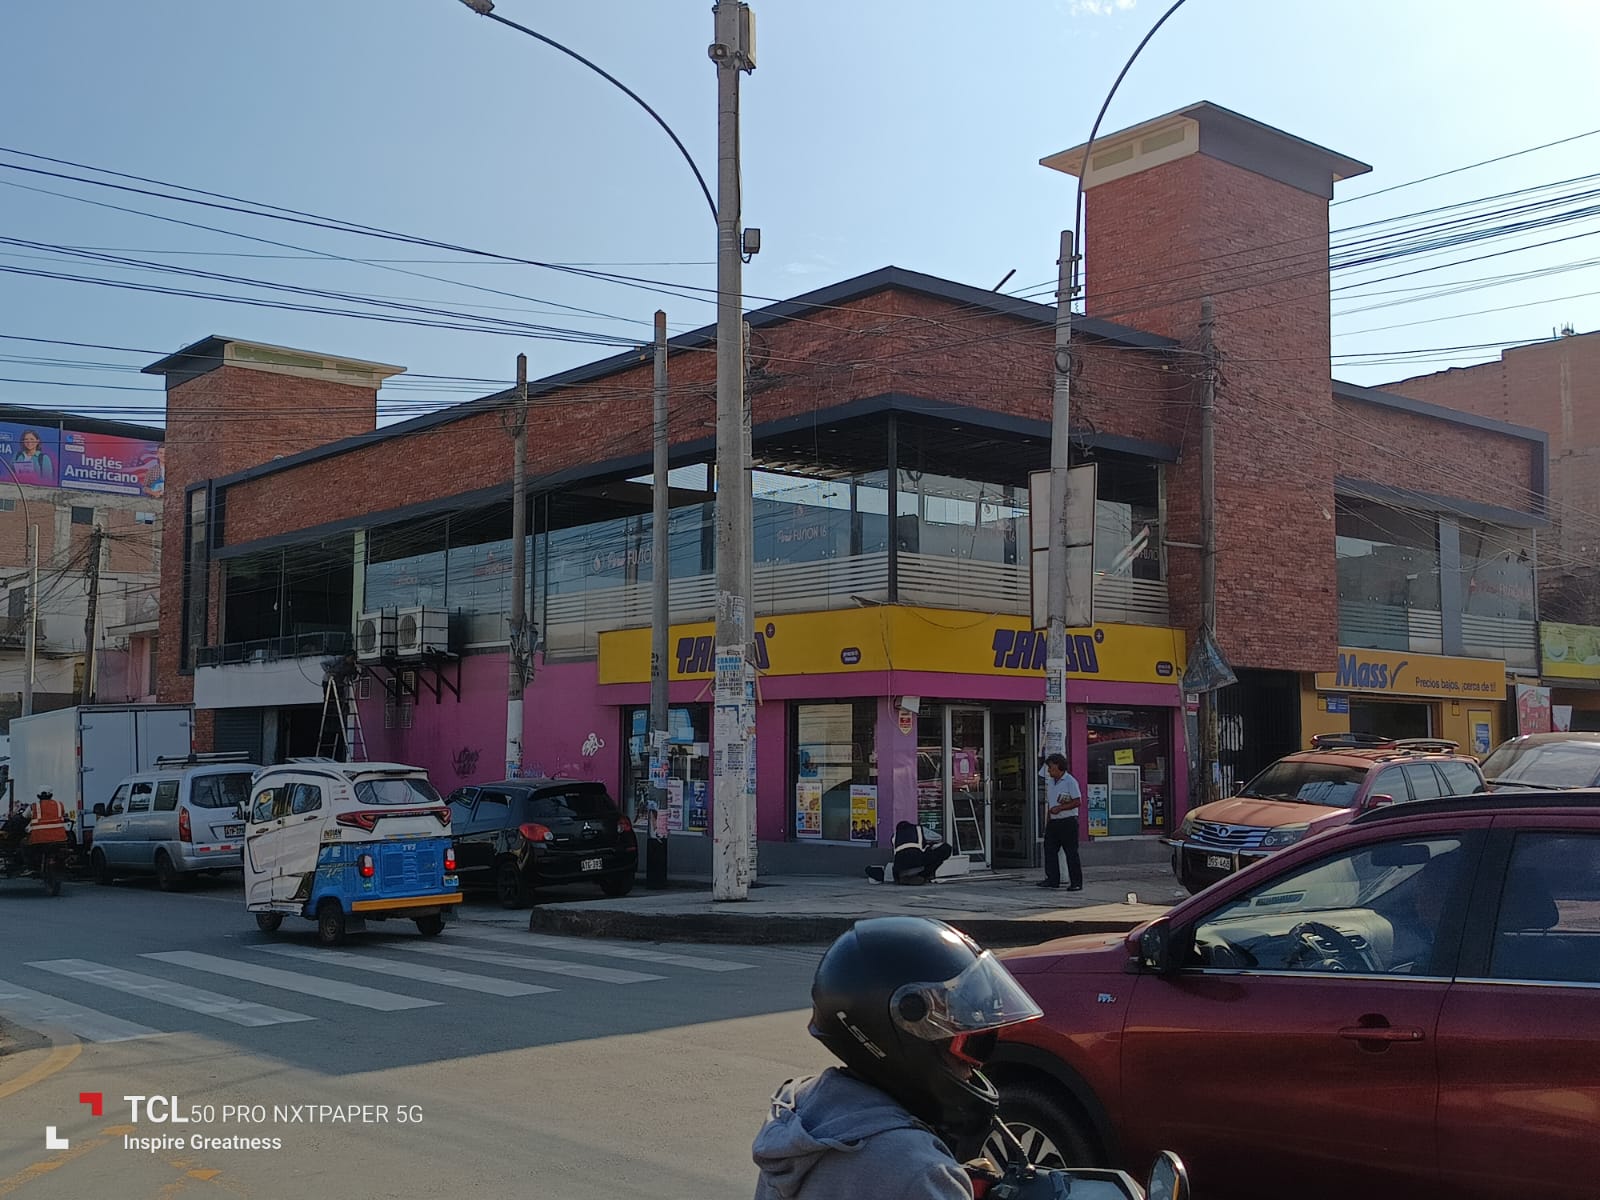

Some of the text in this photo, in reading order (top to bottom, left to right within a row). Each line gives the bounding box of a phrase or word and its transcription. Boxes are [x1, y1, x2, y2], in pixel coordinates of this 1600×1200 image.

[81, 454, 123, 470] Inglés
[64, 465, 139, 483] Americano
[1335, 653, 1388, 689] Mass
[1415, 676, 1440, 690] Precios
[1481, 680, 1489, 691] de
